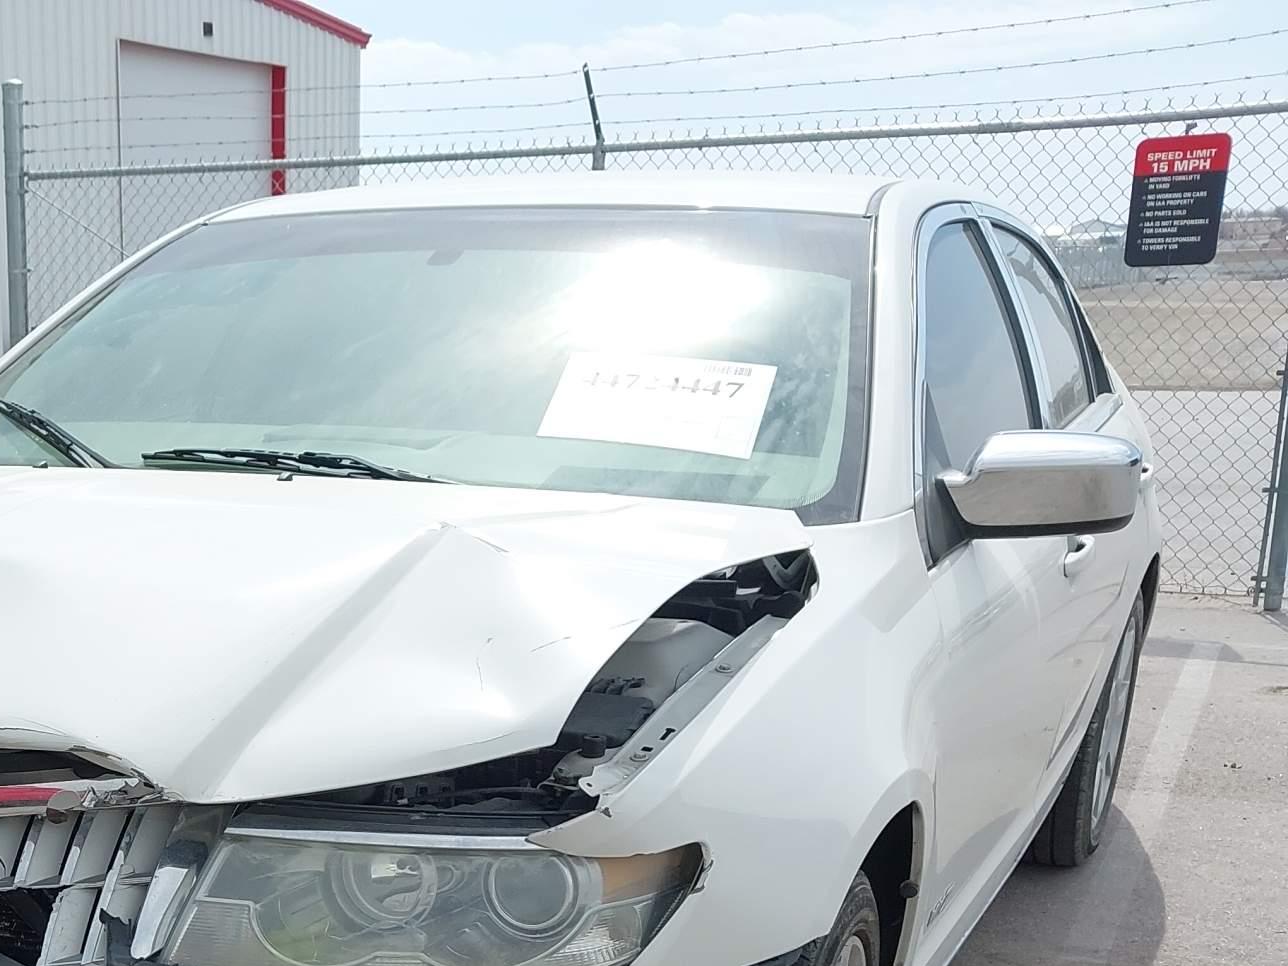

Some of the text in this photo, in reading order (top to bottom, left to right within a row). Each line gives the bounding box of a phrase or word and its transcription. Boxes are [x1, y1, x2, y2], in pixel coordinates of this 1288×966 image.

[1147, 149, 1217, 161] SPEED LIMIT
[1152, 159, 1211, 173] 15 MPH
